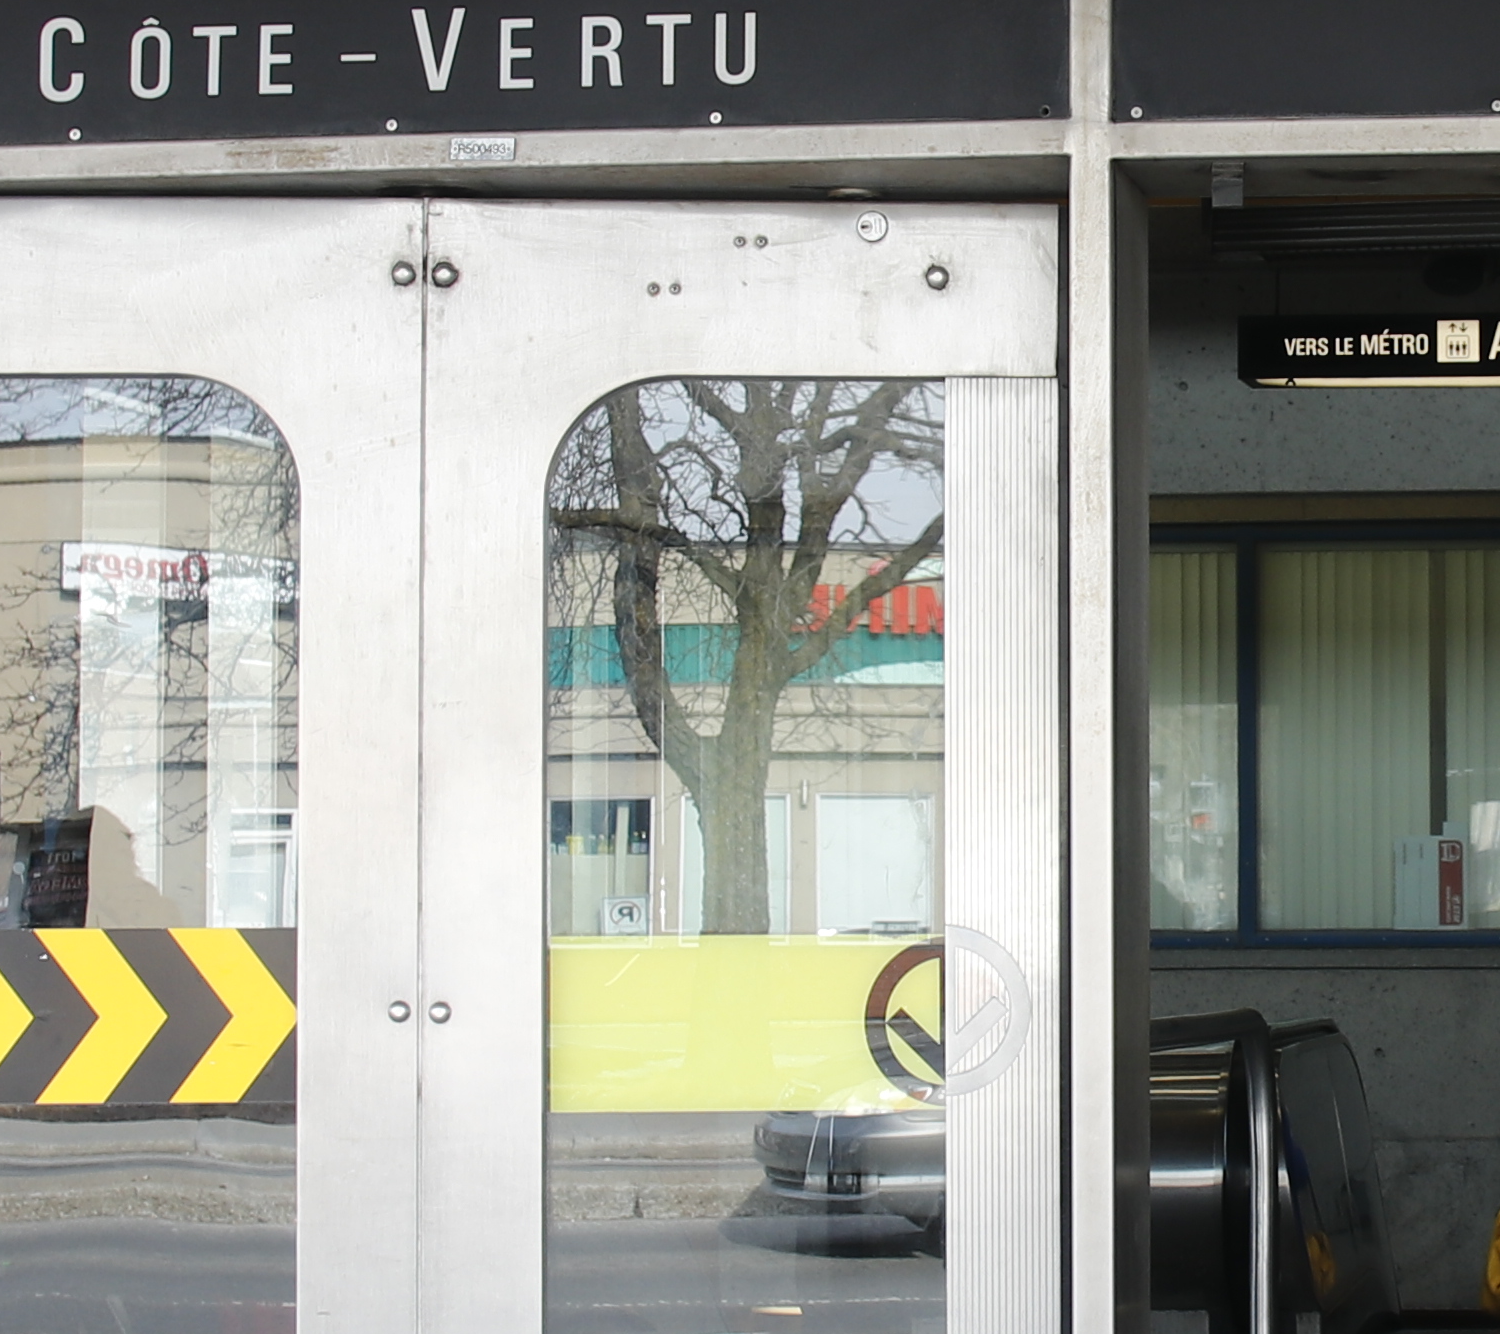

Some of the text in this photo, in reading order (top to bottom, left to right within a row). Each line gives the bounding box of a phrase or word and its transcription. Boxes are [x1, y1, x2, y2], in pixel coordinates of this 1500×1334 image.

[1284, 337, 1329, 356] VERS
[1335, 337, 1354, 355] LE
[1360, 328, 1429, 356] MÉTRO
